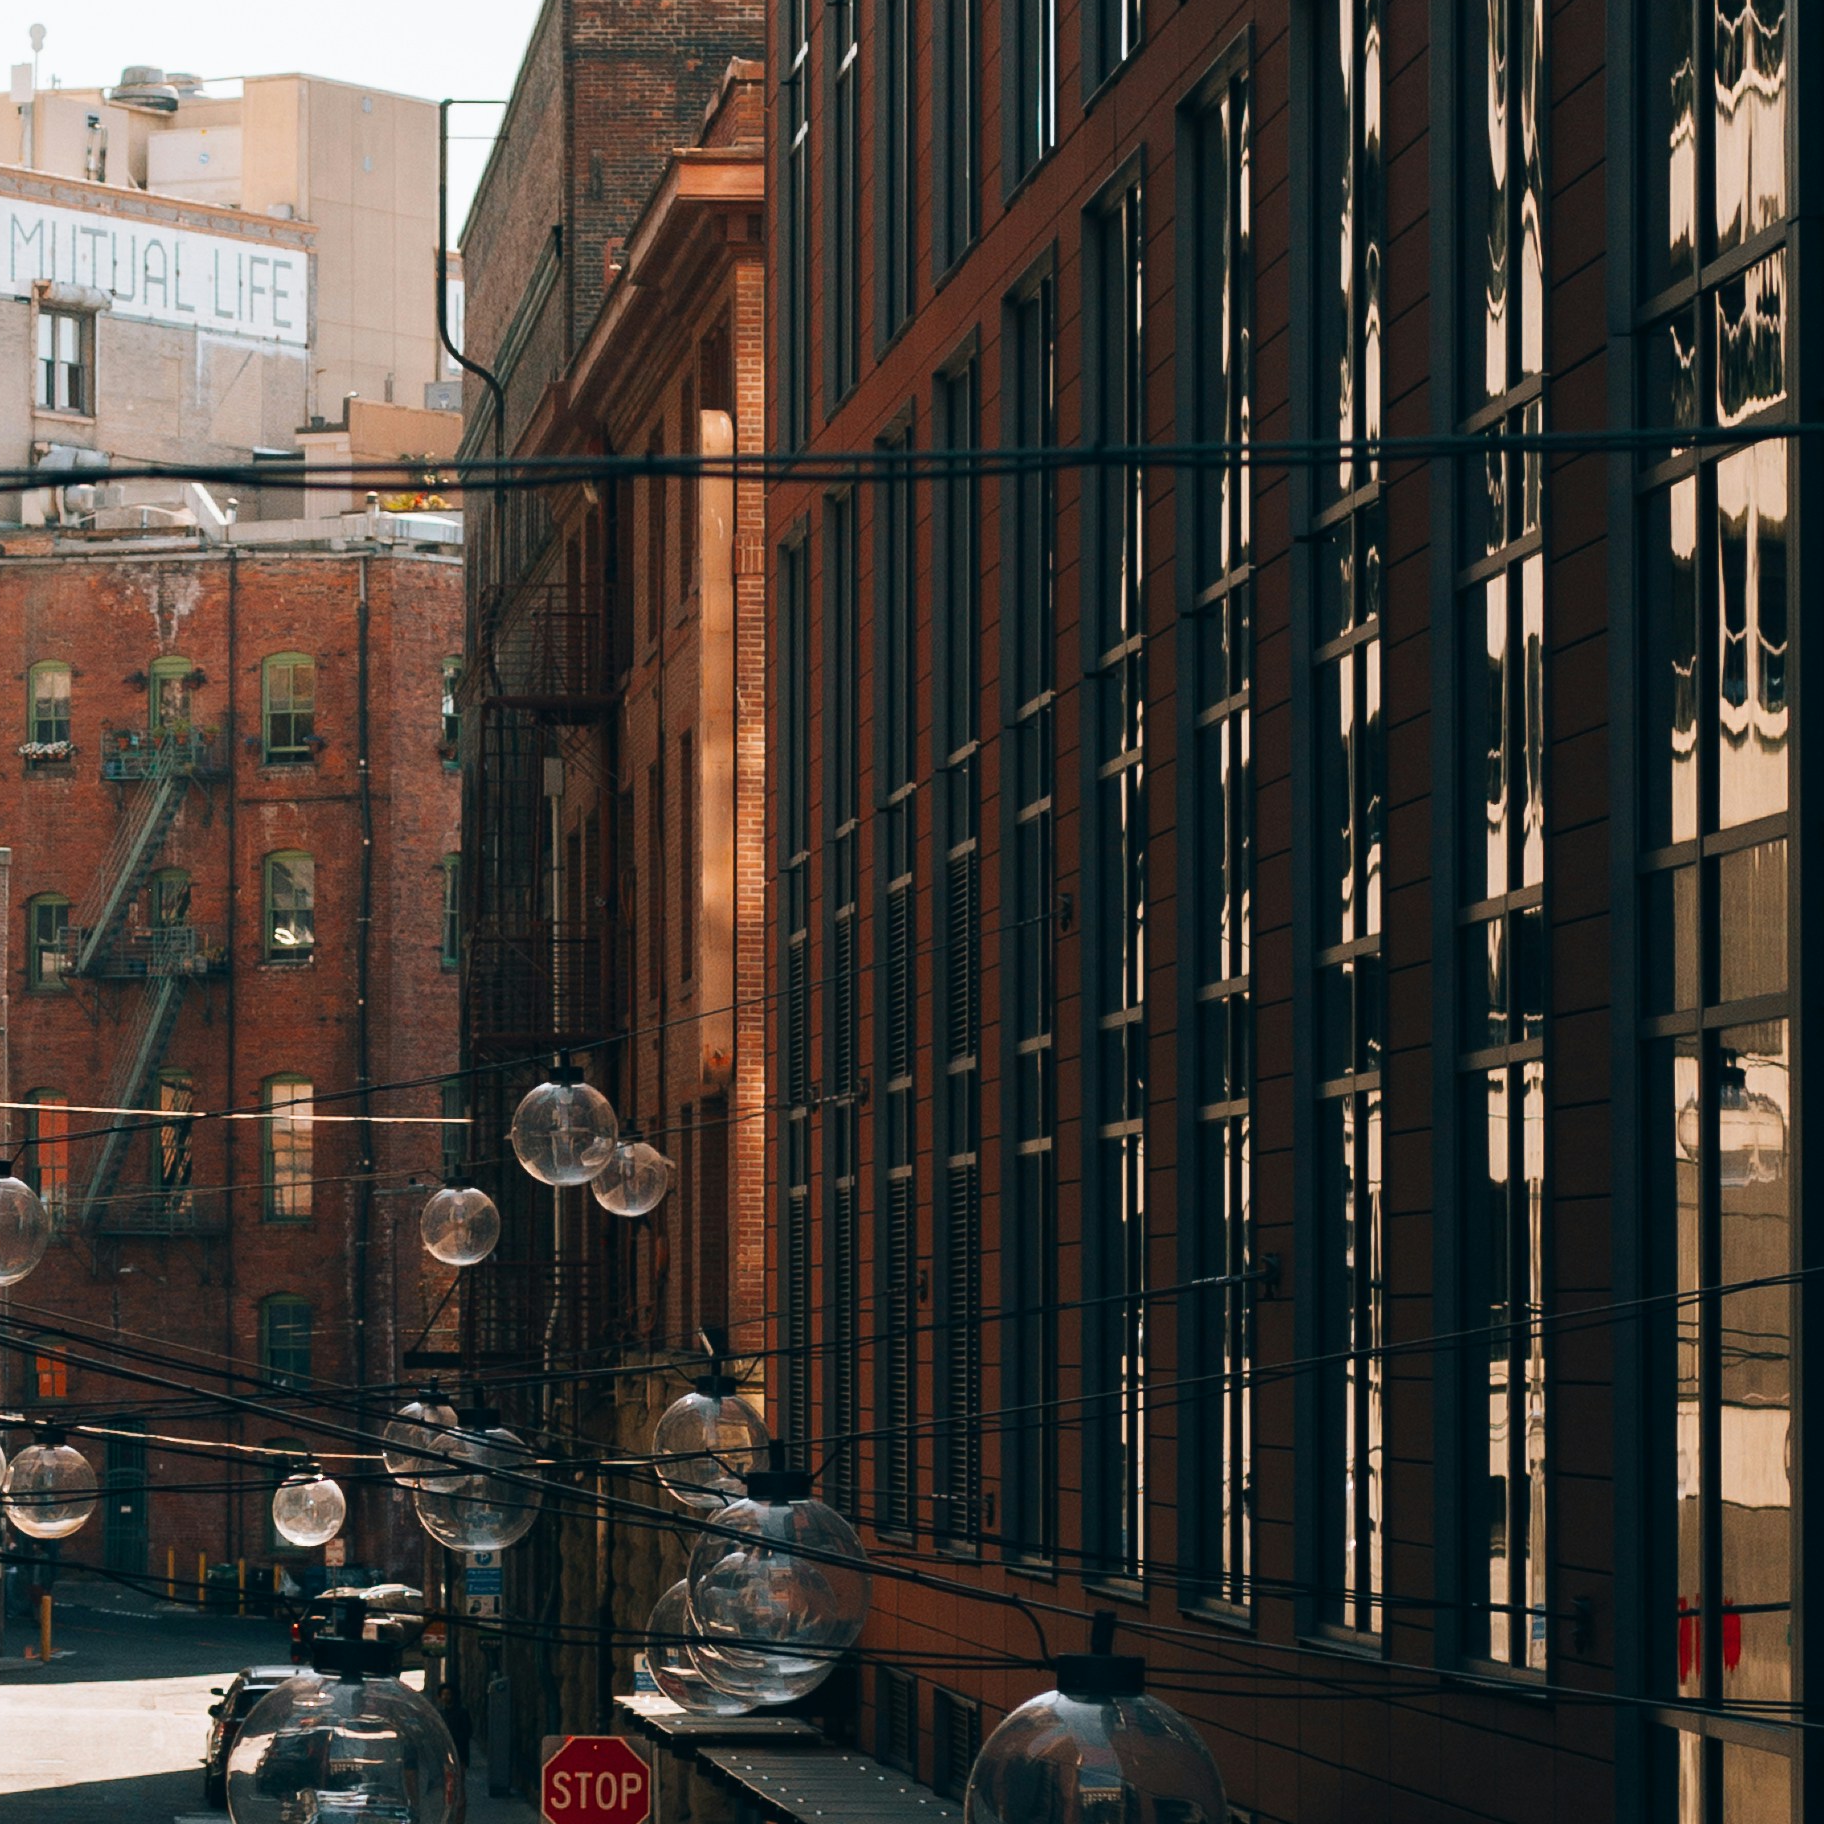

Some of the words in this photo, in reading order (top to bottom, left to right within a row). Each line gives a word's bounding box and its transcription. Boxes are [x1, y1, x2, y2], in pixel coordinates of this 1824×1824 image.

[10, 213, 195, 312] MUTUAL
[214, 248, 293, 328] LIFE
[551, 1771, 642, 1810] STOP
